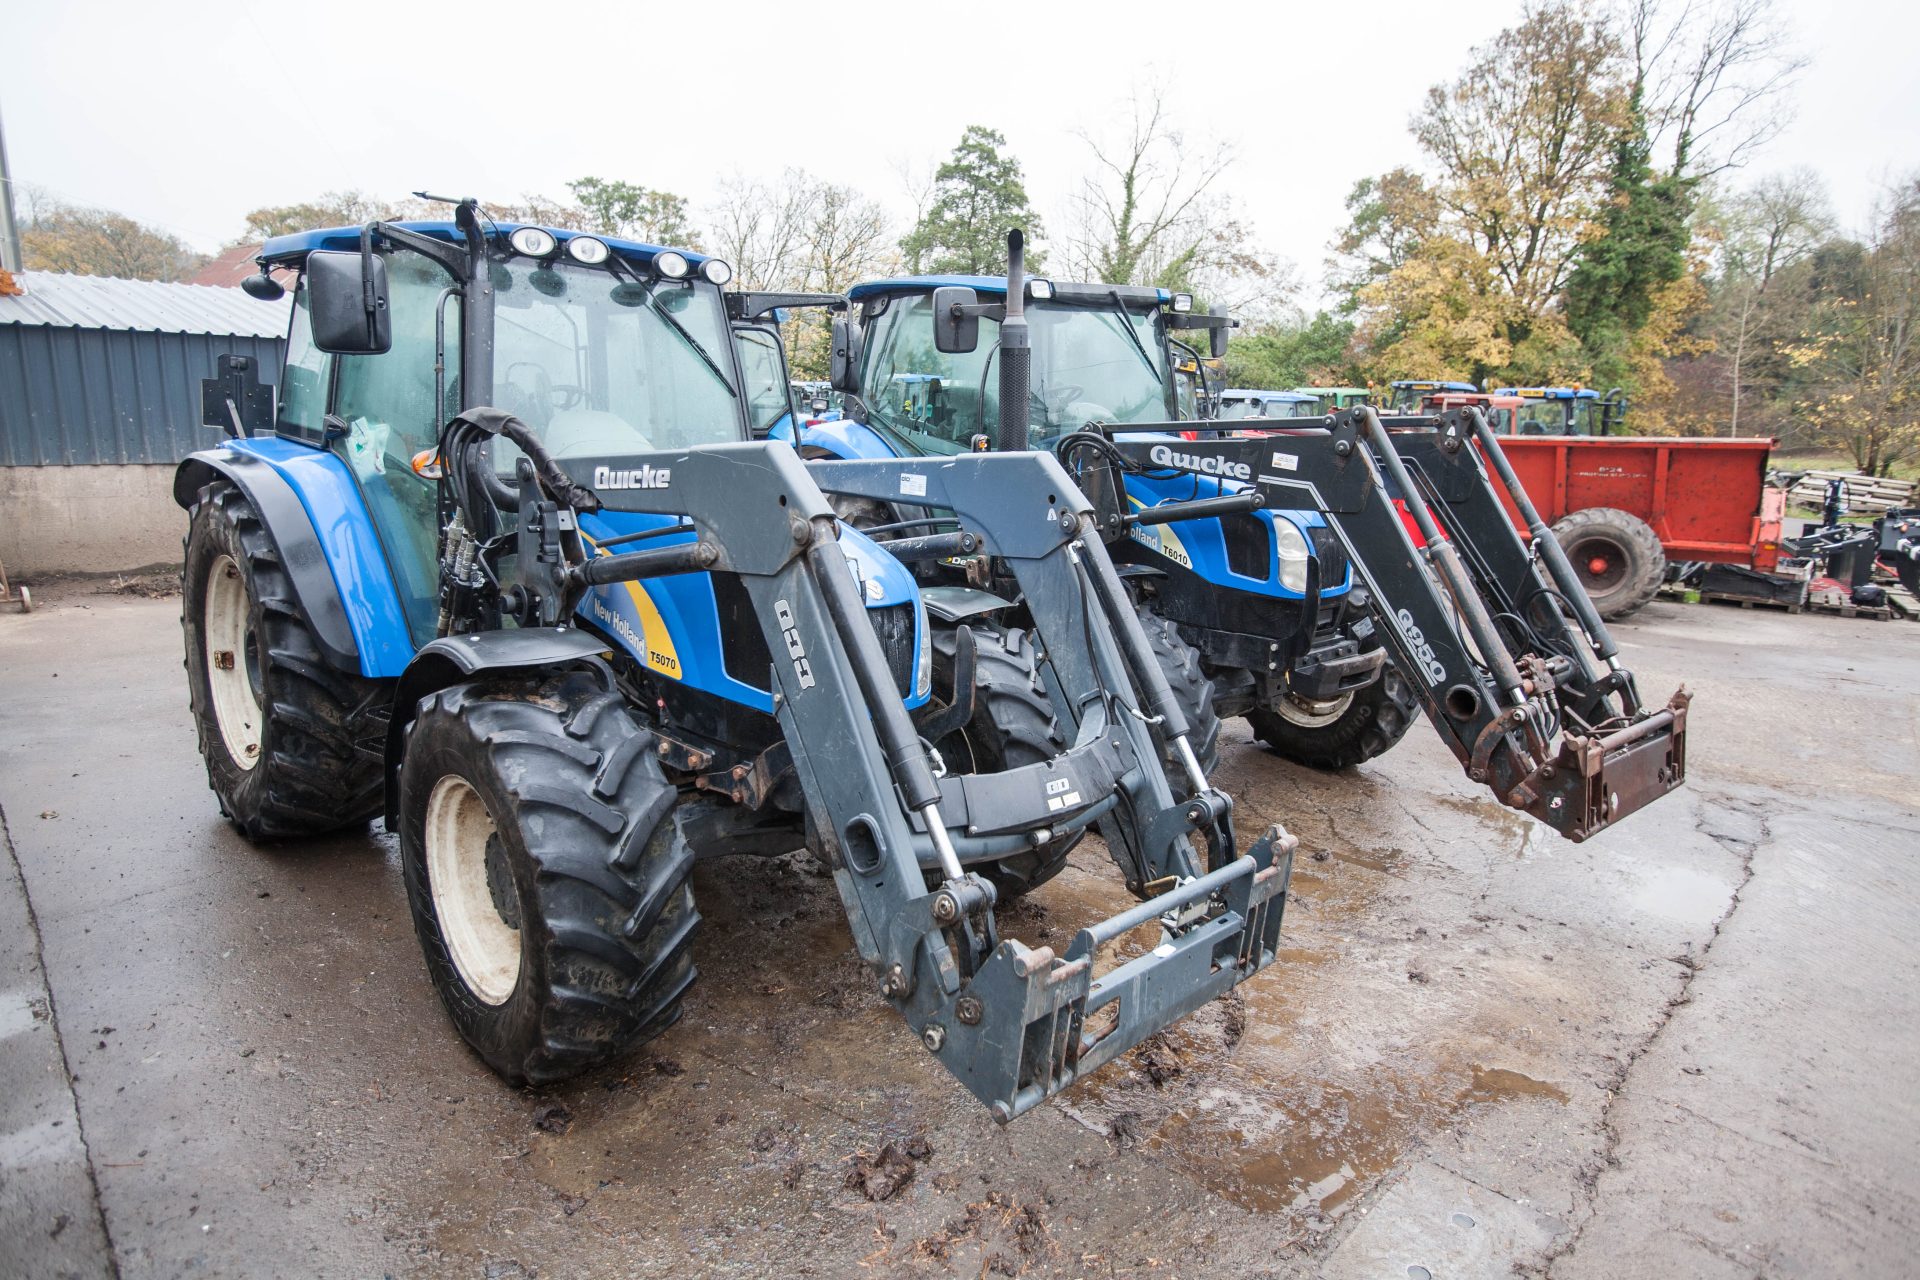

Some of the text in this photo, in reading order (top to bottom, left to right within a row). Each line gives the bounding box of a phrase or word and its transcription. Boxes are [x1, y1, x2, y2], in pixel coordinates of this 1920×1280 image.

[1150, 445, 1251, 480] Quicke
[595, 464, 671, 489] Quicke
[1130, 526, 1158, 548] olland
[1163, 544, 1188, 565] T6010
[594, 598, 645, 657] New Holland
[1397, 608, 1447, 683] Q950
[650, 651, 676, 670] T5070
